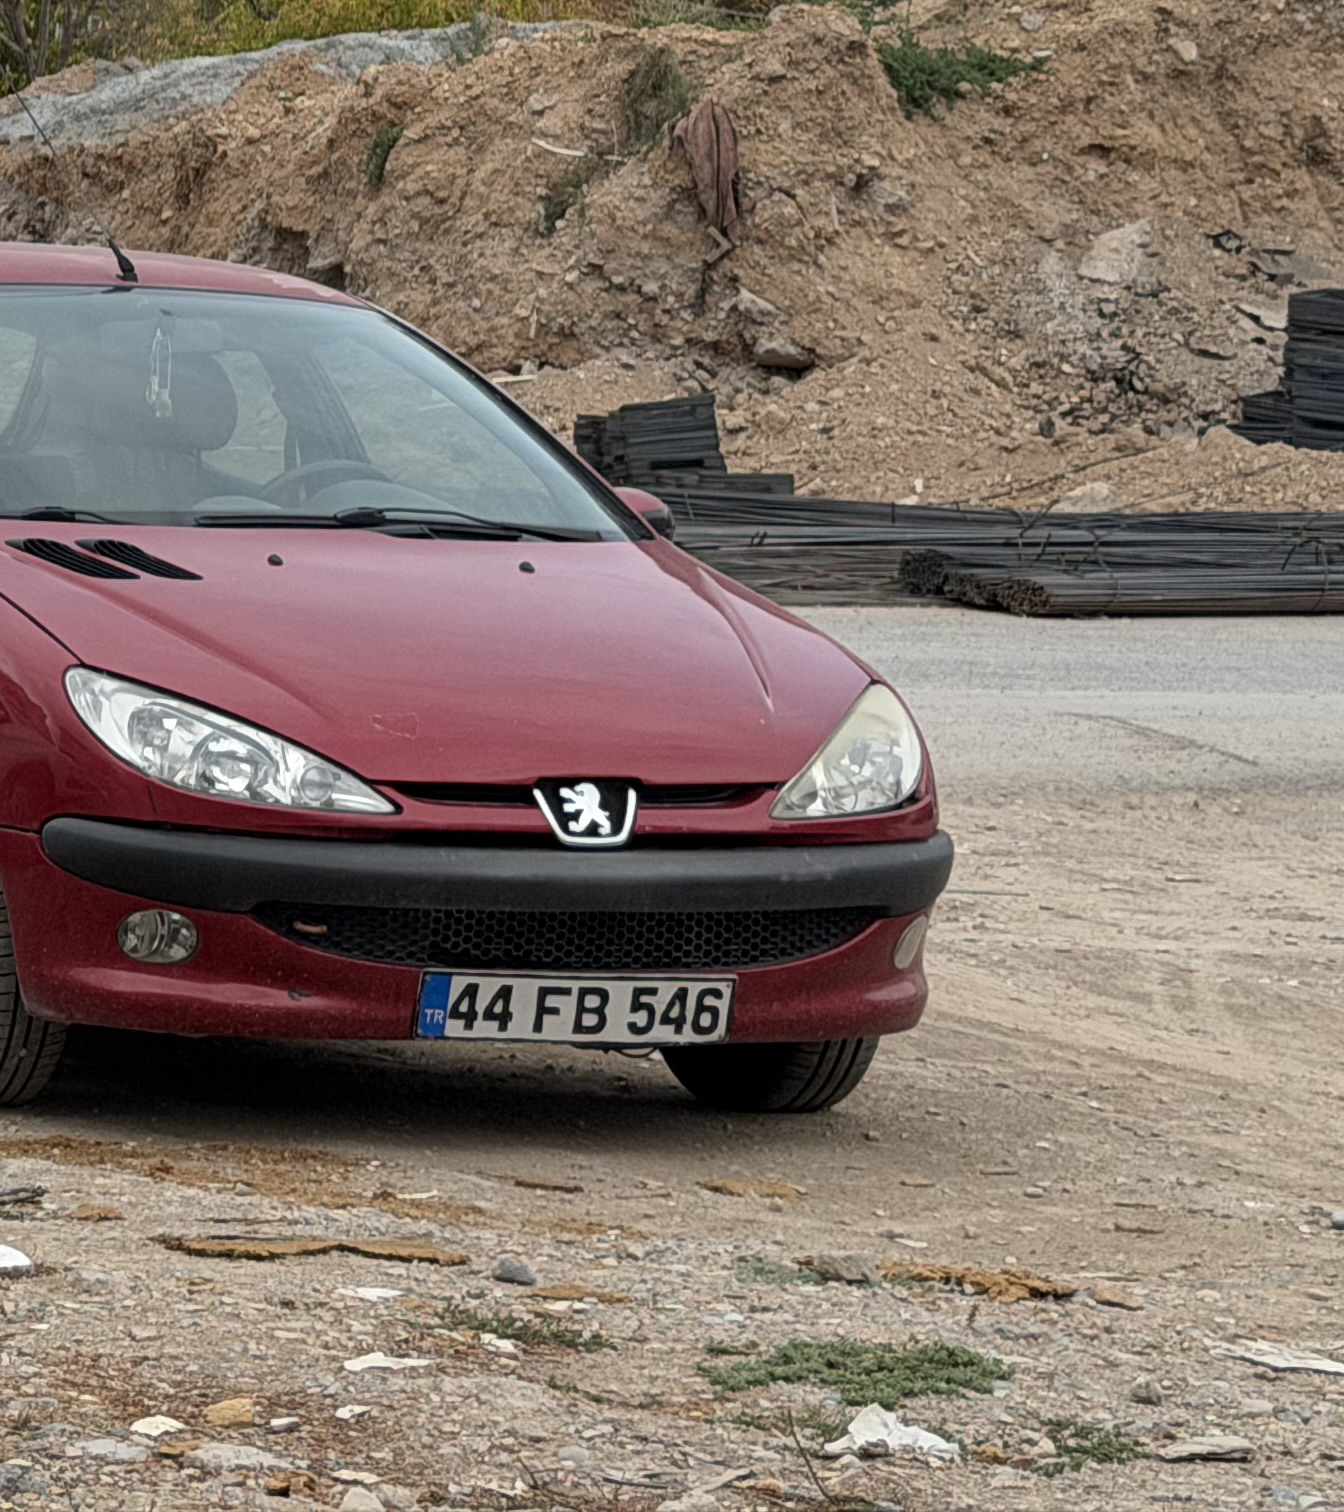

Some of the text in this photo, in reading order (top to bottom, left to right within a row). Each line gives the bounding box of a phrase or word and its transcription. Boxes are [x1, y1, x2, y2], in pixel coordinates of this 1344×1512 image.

[424, 982, 724, 1036] TR 44 FB 546
